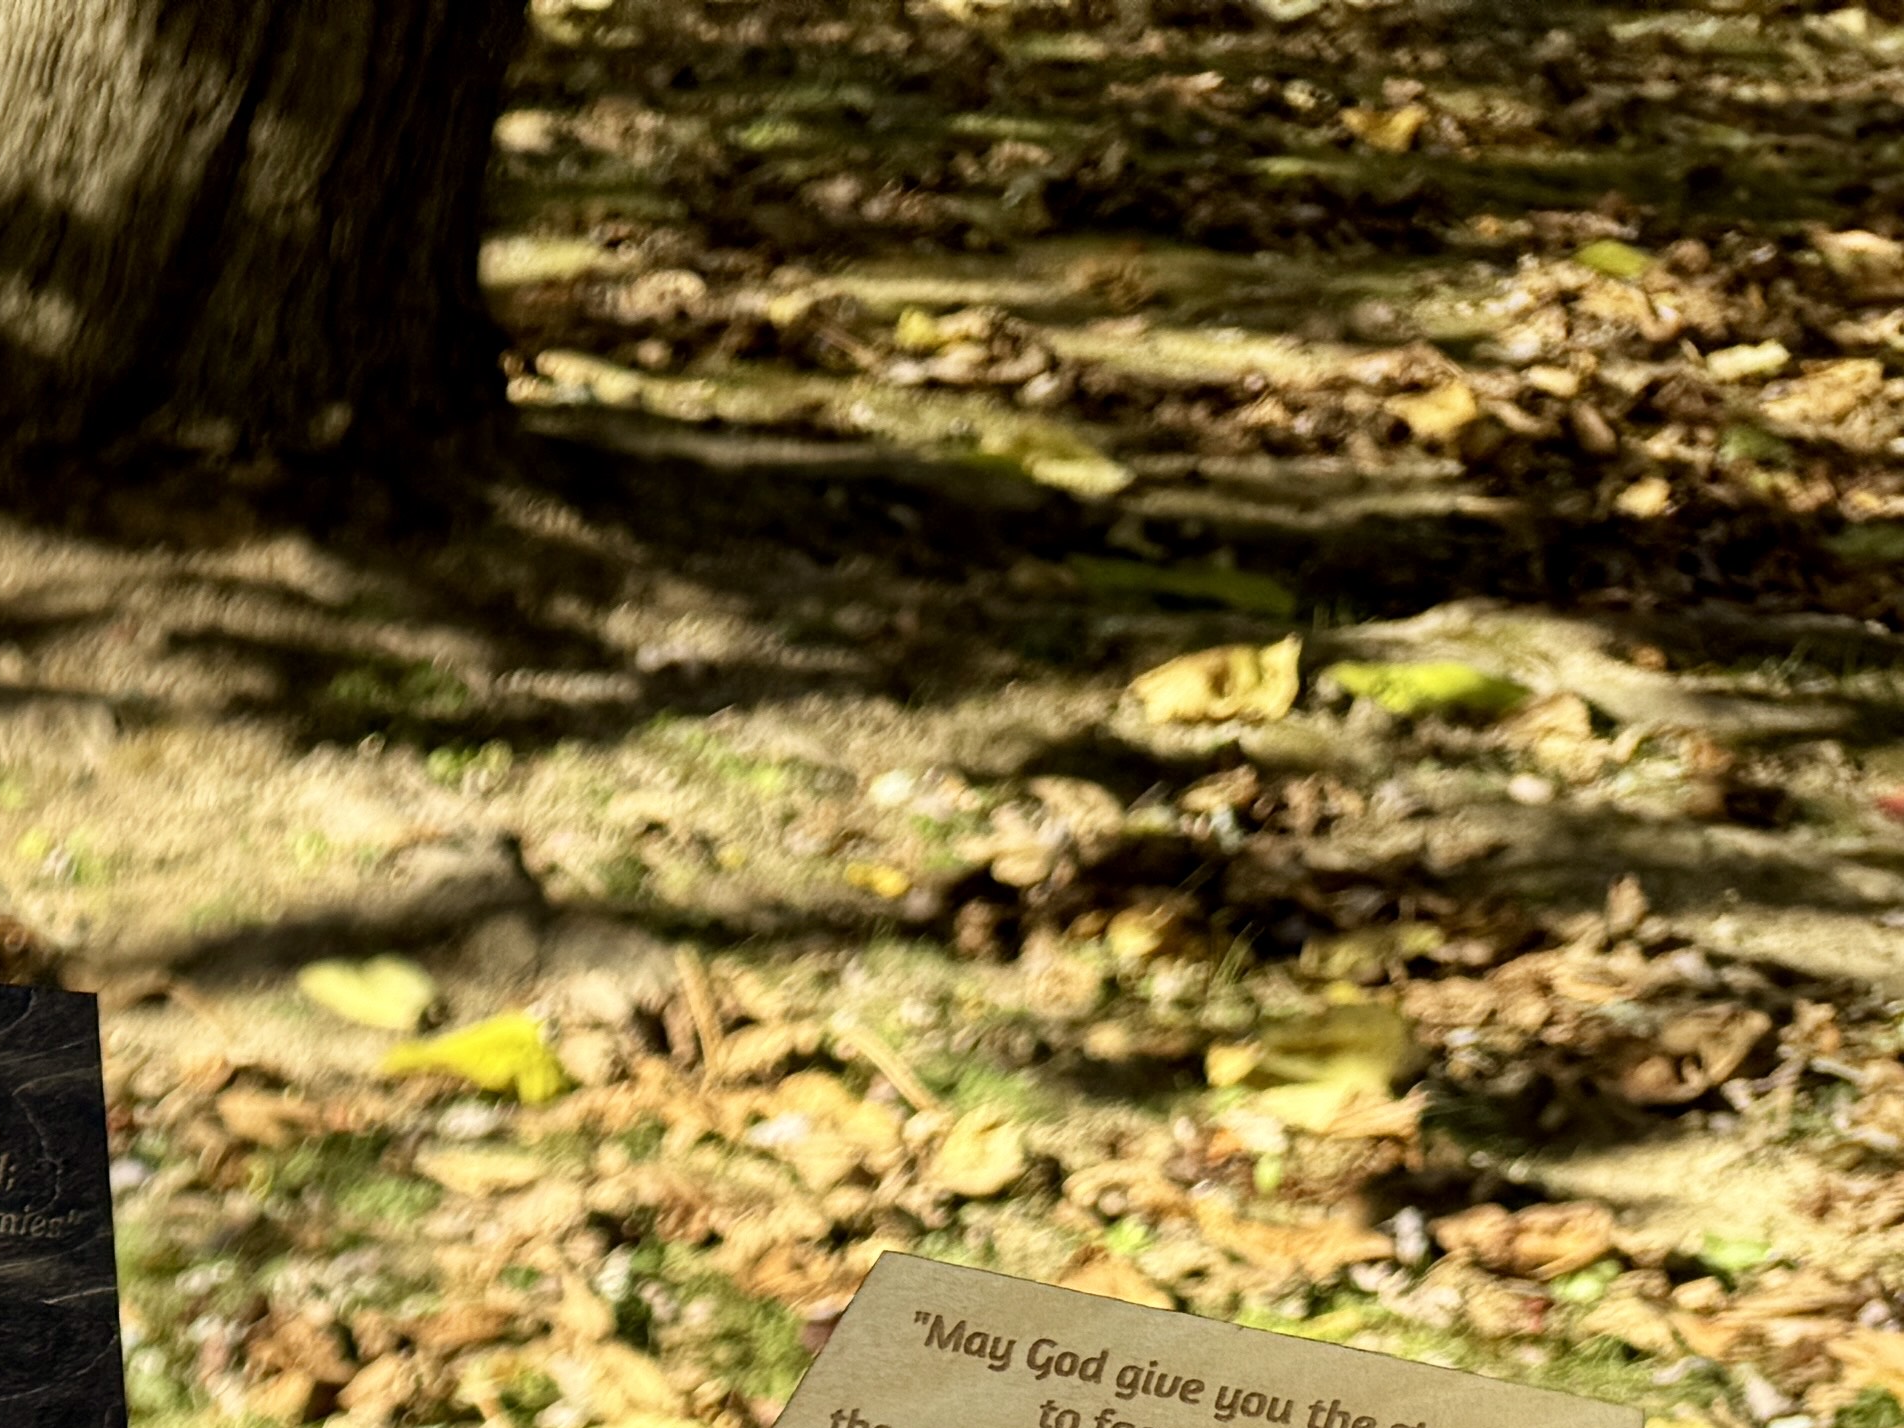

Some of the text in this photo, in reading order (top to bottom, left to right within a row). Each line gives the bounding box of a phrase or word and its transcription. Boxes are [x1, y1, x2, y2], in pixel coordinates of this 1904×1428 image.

[914, 1311, 1016, 1372] "May
[1027, 1338, 1109, 1384] God
[1115, 1360, 1204, 1404] give
[1214, 1386, 1293, 1424] you
